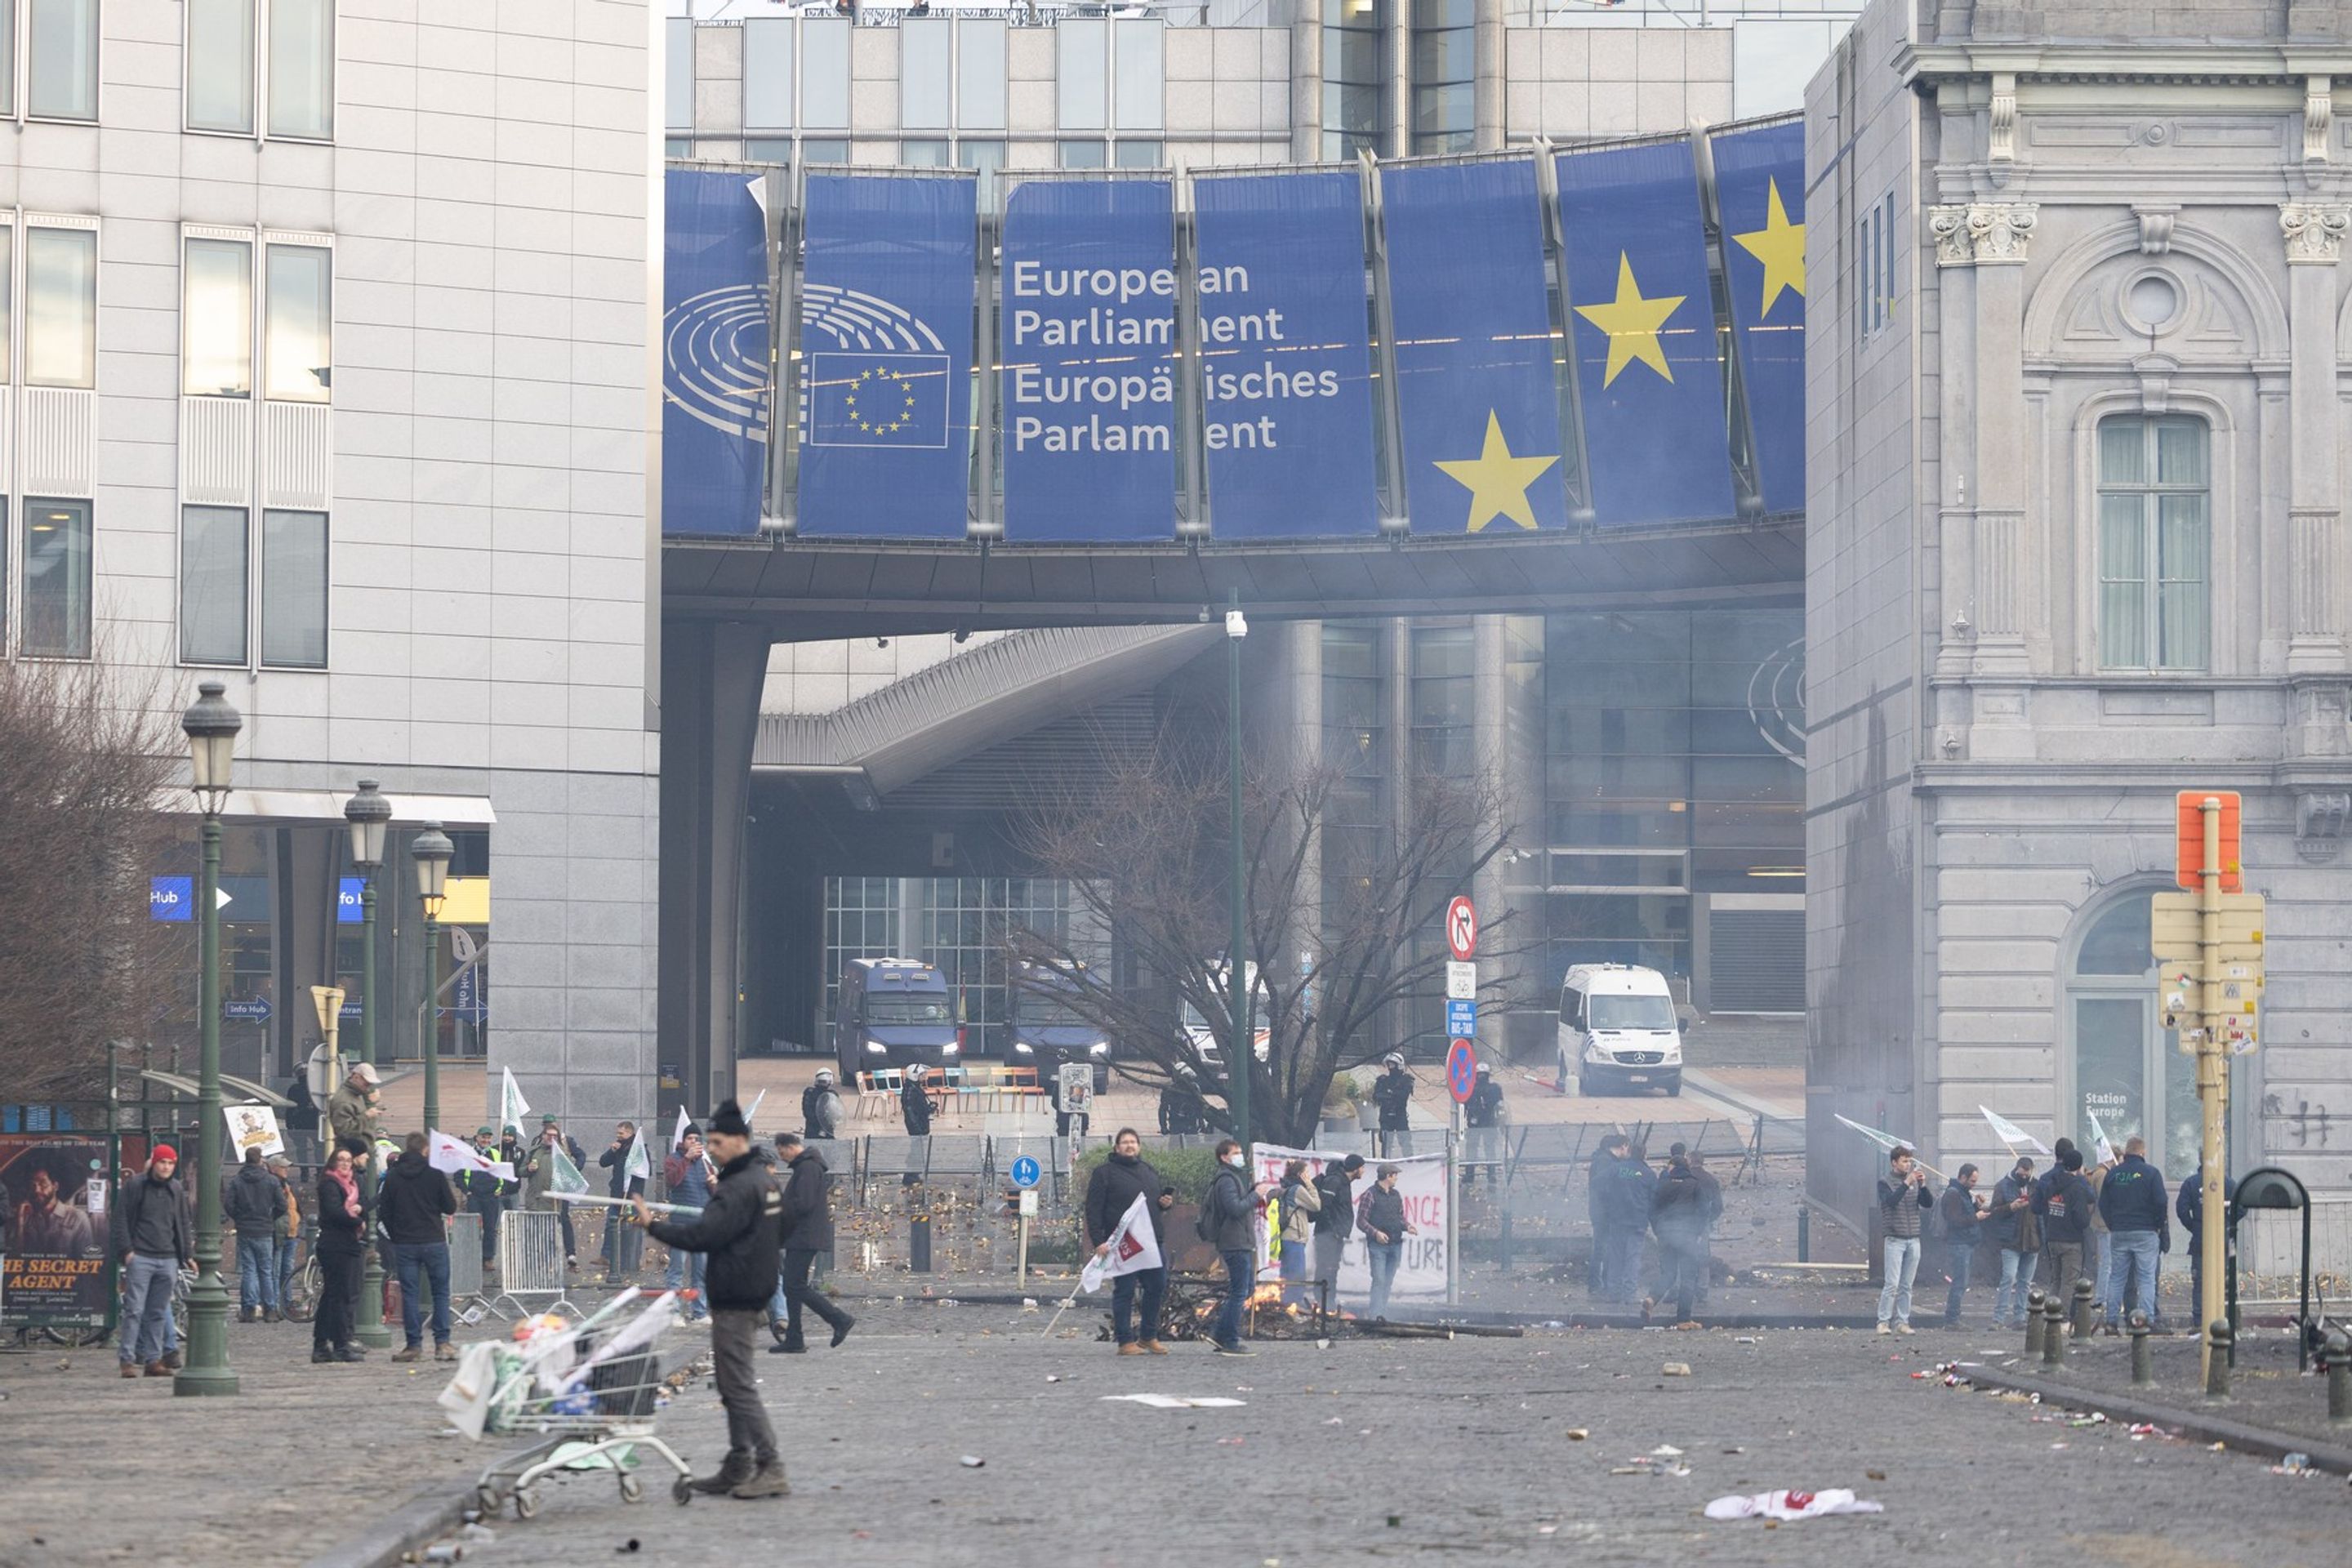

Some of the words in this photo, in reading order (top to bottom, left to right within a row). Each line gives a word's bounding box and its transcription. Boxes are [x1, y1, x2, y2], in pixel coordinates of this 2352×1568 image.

[1014, 261, 1249, 304] European
[1015, 307, 1285, 345] Parliament
[1015, 361, 1339, 411] Europäisches
[1016, 415, 1277, 452] Parlament
[149, 890, 178, 904] Hub
[230, 1004, 247, 1013] Info
[249, 1004, 266, 1013] Hub
[2085, 1092, 2127, 1105] Station
[2086, 1105, 2125, 1119] Europe
[3, 1258, 25, 1273] HE
[29, 1259, 104, 1274] SECRET
[8, 1275, 77, 1289] AGENT
